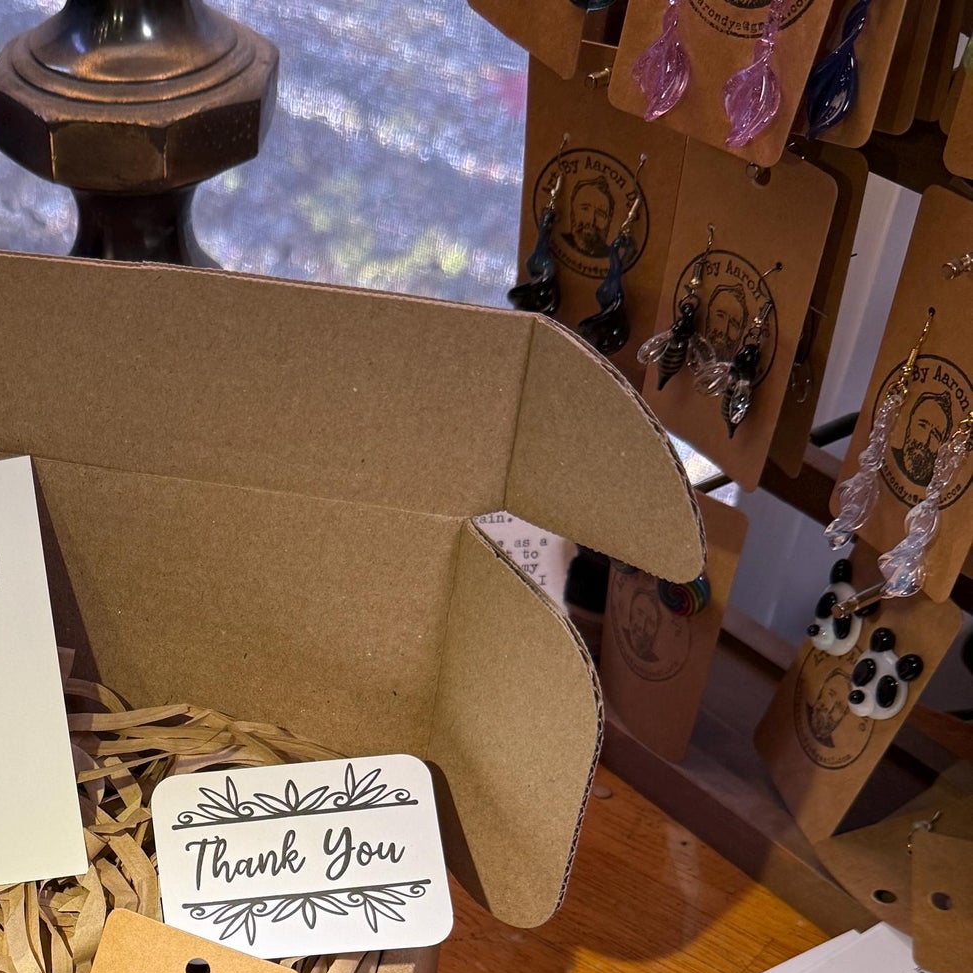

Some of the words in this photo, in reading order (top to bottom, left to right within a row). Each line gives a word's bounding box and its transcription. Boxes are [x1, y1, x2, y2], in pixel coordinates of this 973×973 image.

[562, 160, 580, 175] By
[584, 156, 627, 189] Aaron
[706, 260, 721, 277] By
[725, 259, 763, 301] Aaron
[912, 363, 930, 384] By
[932, 365, 971, 412] Aaron
[523, 549, 539, 560] to
[184, 828, 307, 891] Thank
[323, 826, 406, 881] You
